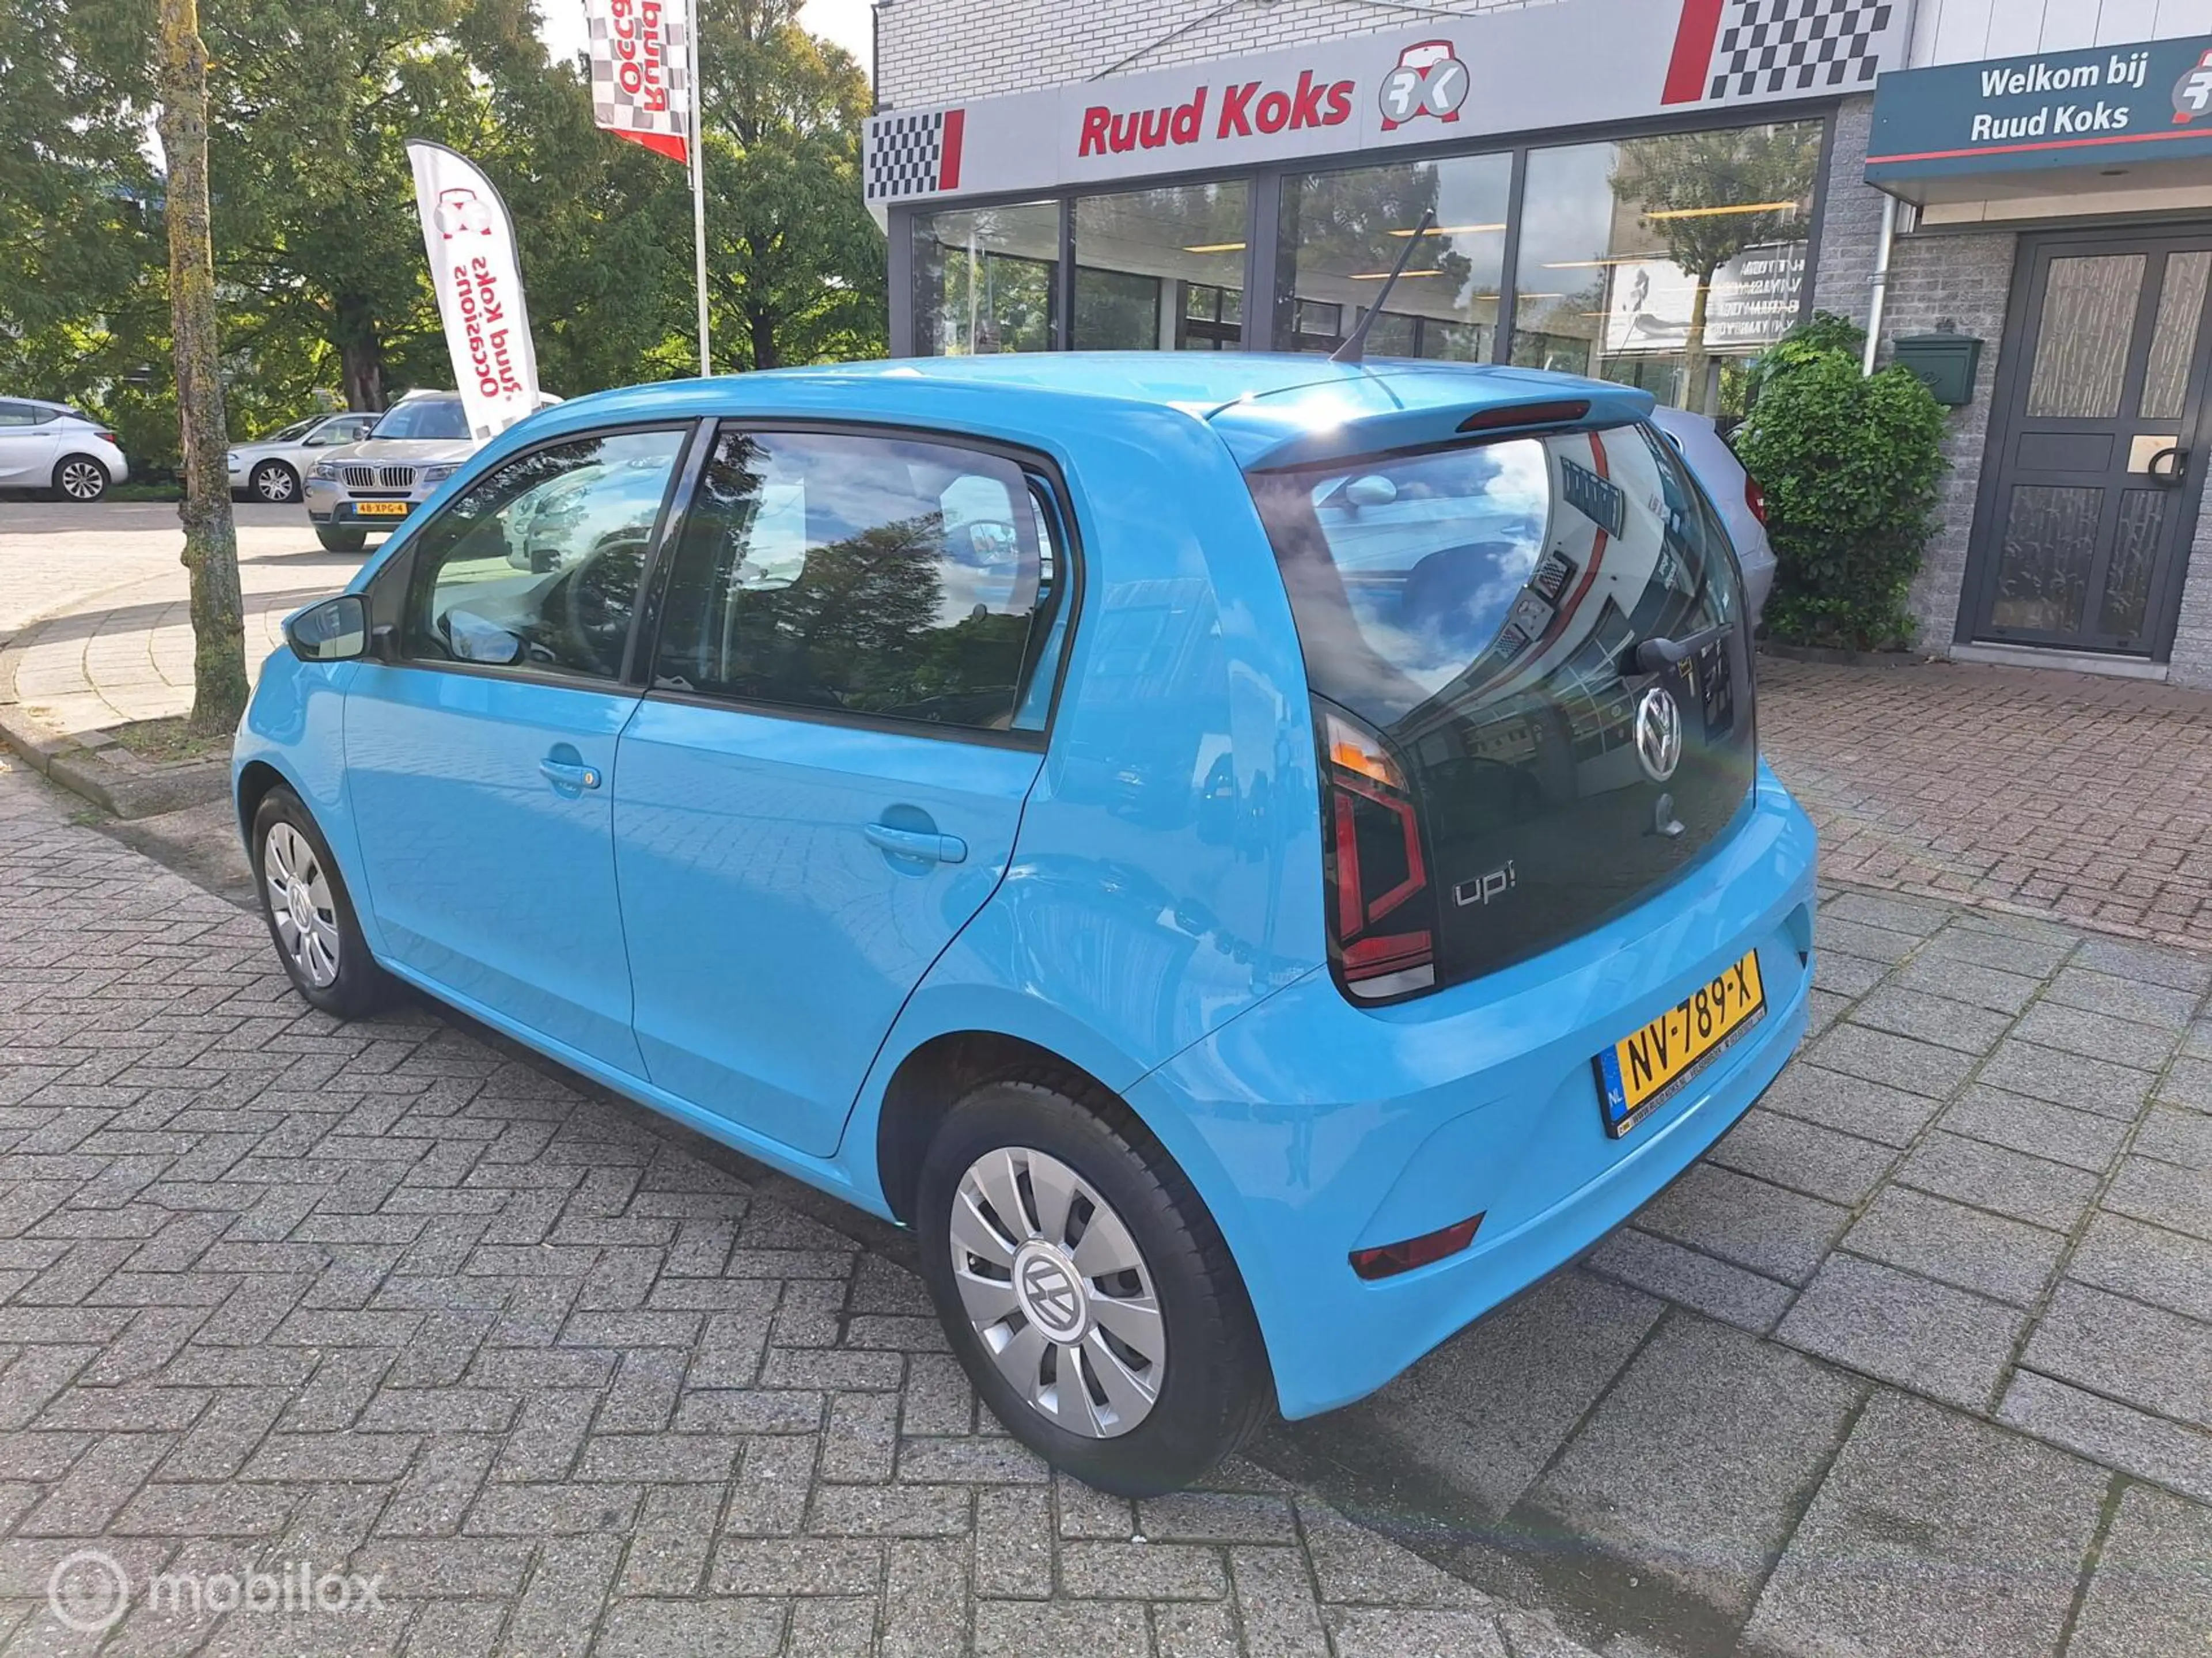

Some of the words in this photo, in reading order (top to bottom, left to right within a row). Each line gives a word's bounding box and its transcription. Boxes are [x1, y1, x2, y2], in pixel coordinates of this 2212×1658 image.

[1980, 63, 2100, 98] Welkom
[2107, 52, 2149, 89] bij
[1078, 86, 1208, 157] Ruud
[1217, 70, 1355, 139] Koks
[1970, 106, 2048, 141] Ruud
[2052, 101, 2130, 135] Koks
[1454, 860, 1516, 906] up!
[1608, 1087, 1623, 1109] NL
[1627, 957, 1751, 1091] NV-789-X
